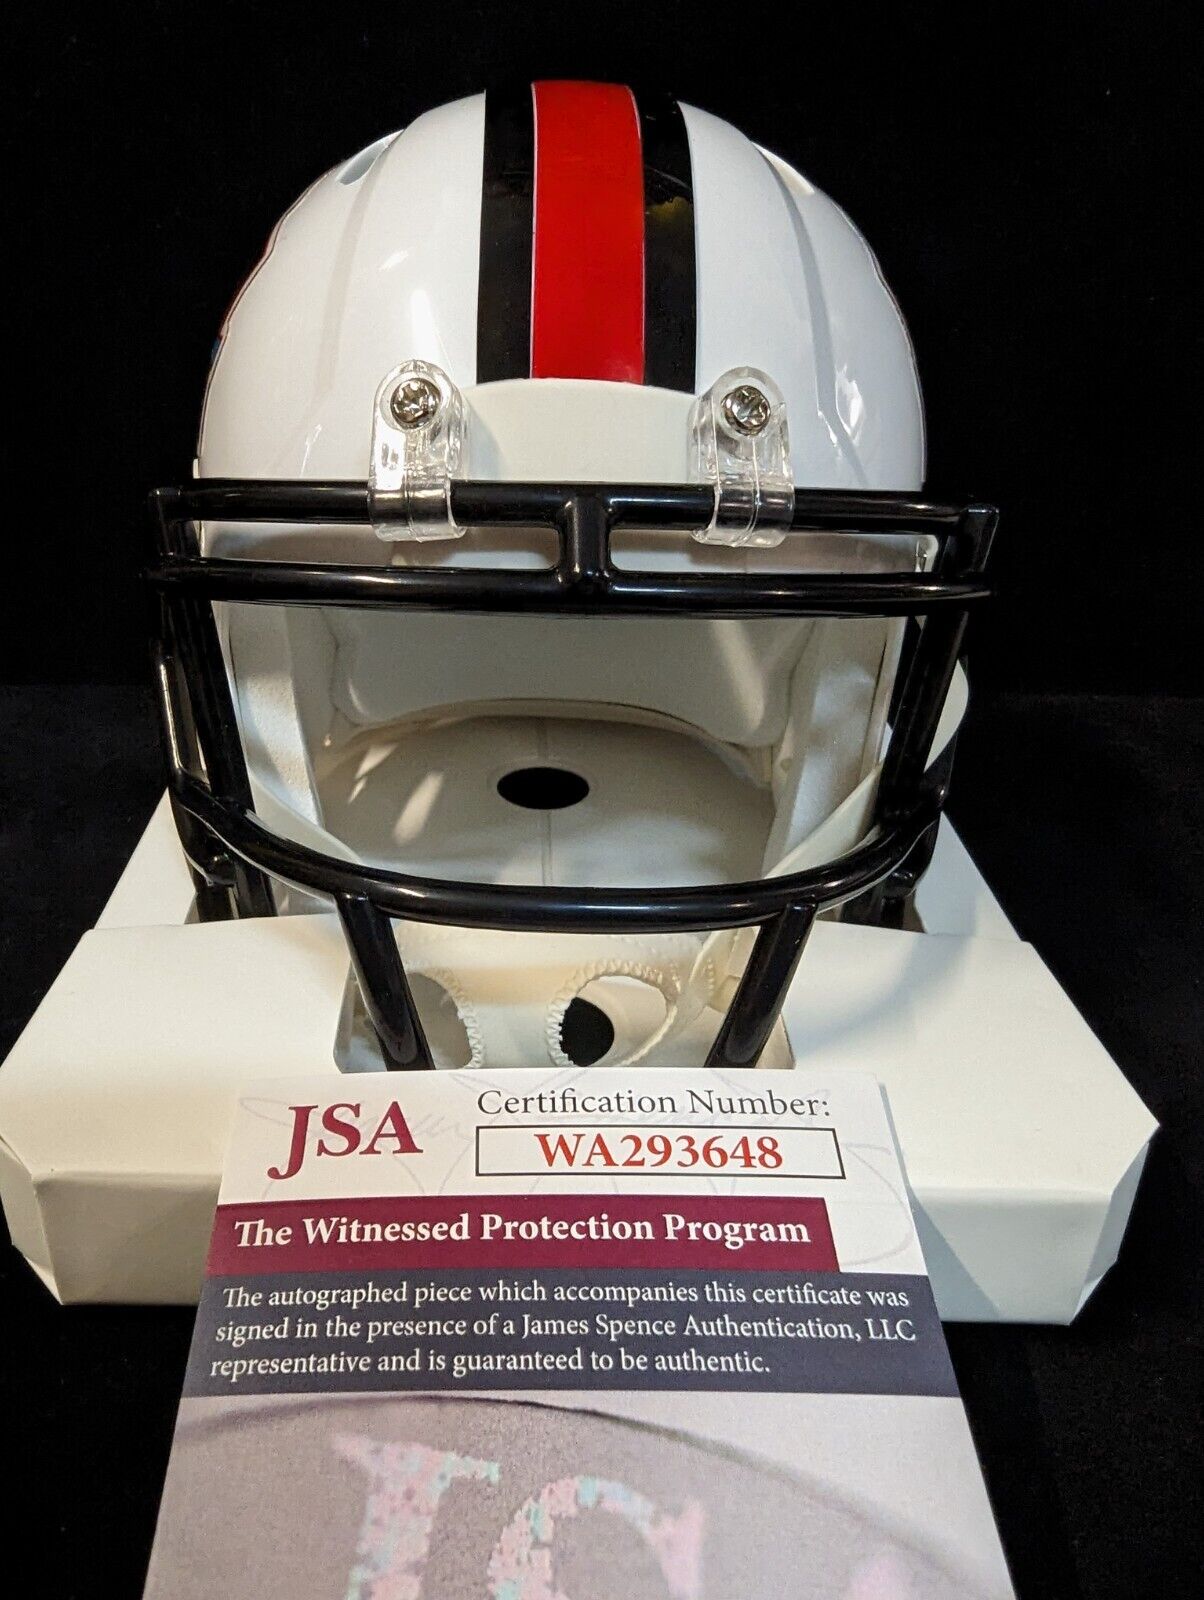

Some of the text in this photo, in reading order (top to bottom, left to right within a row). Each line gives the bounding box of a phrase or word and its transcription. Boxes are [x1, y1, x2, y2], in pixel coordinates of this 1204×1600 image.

[477, 1087, 830, 1116] Certification Number:
[267, 1101, 424, 1180] JSA
[533, 1133, 783, 1169] WA293648
[234, 1212, 812, 1250] The Witnessed Protection Program
[222, 1279, 910, 1311] The autographed piece which accompanies this certificate was
[215, 1312, 916, 1348] signed in the presence of a James Spence Authentication, LLC
[210, 1346, 771, 1382] representative and is guaranteed to be authentic.
